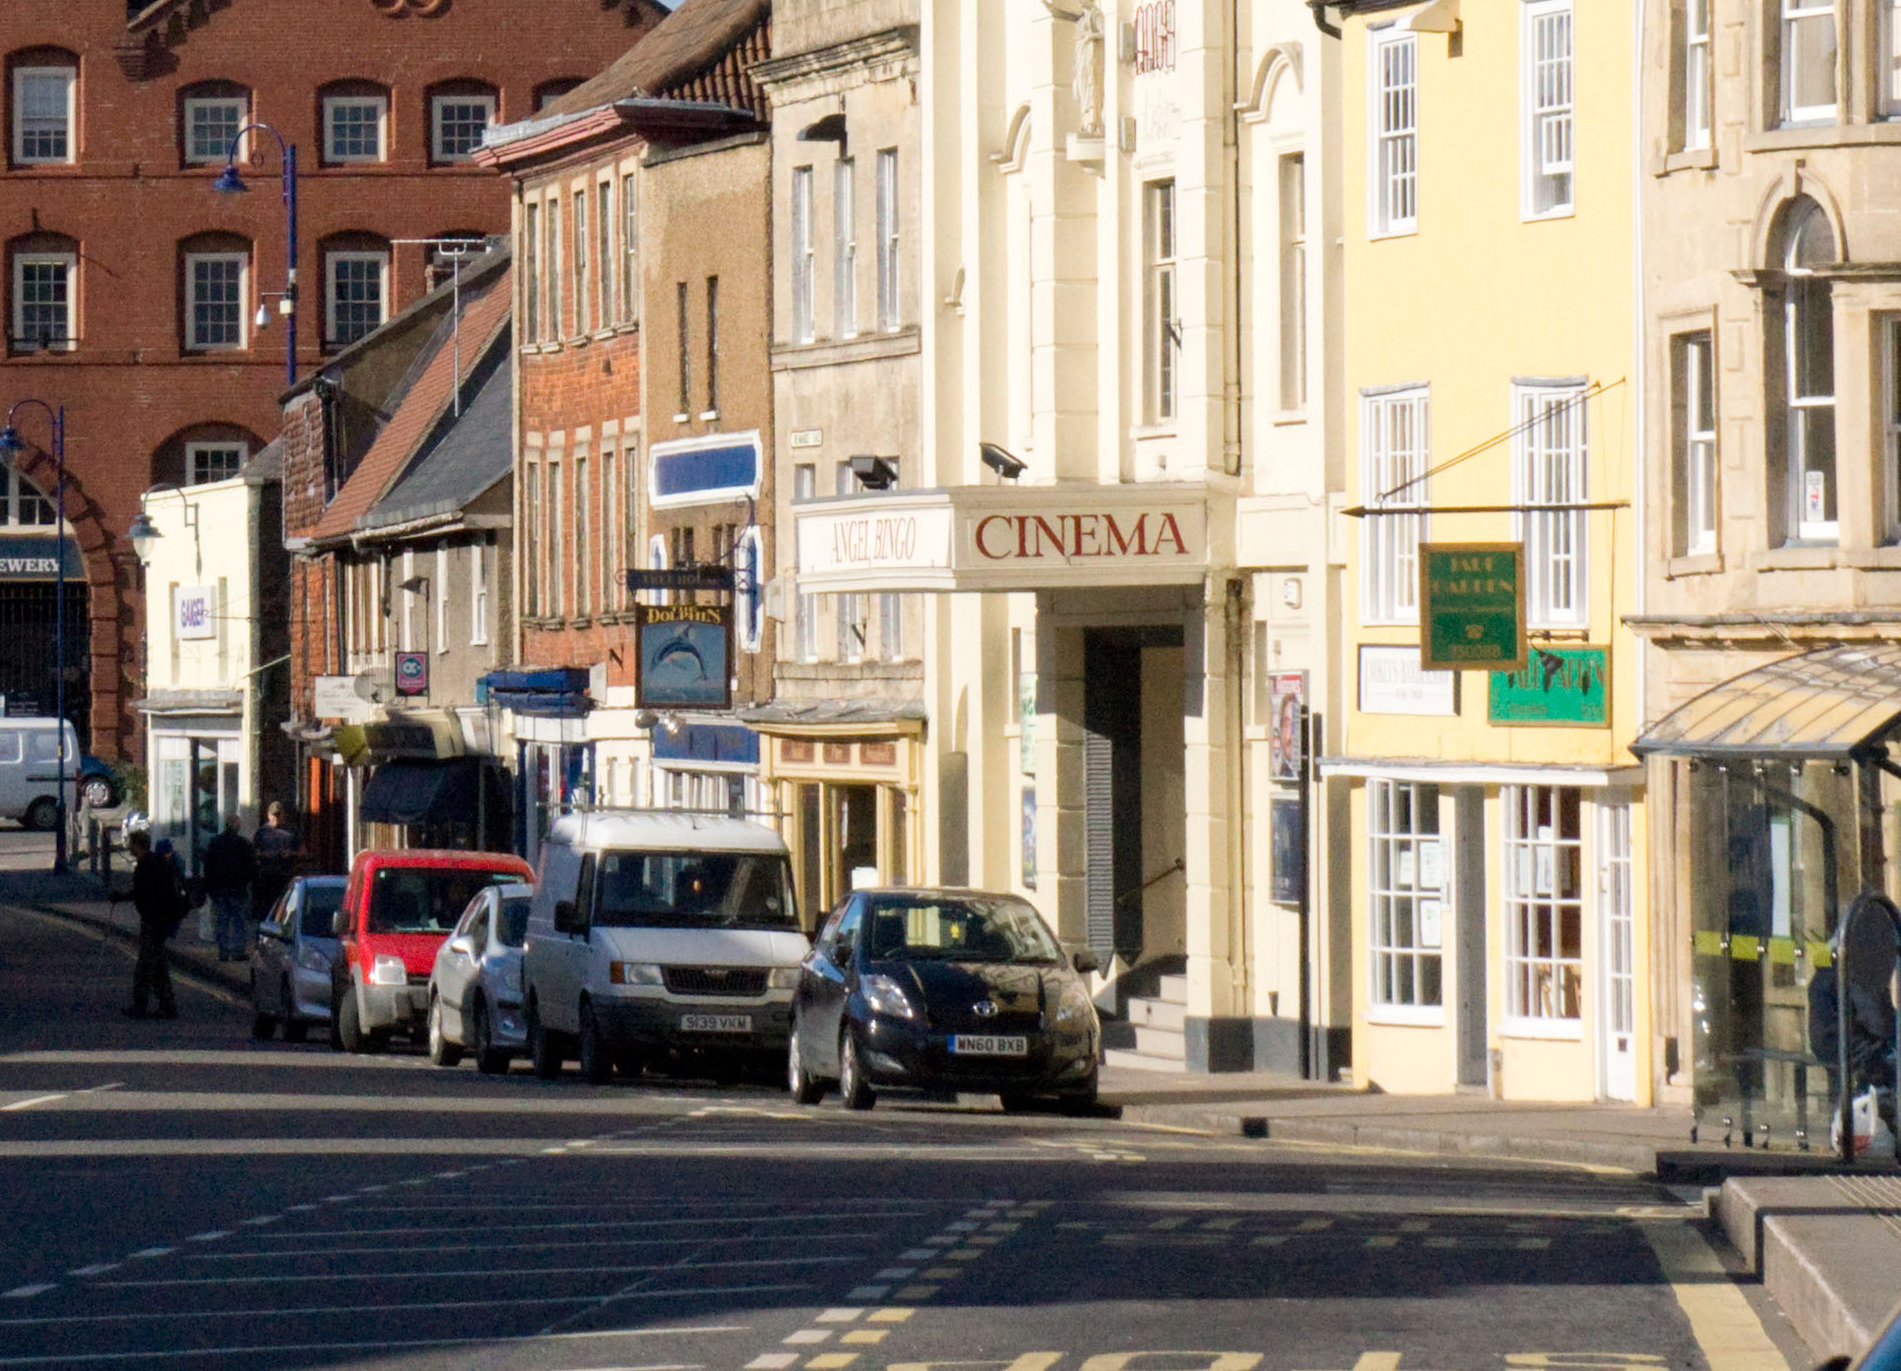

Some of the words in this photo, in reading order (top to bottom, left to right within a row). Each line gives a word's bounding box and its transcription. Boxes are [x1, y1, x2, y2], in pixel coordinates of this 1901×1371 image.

[830, 519, 870, 563] ANGEL
[873, 516, 917, 561] BINGO
[975, 513, 1190, 560] CINEMA
